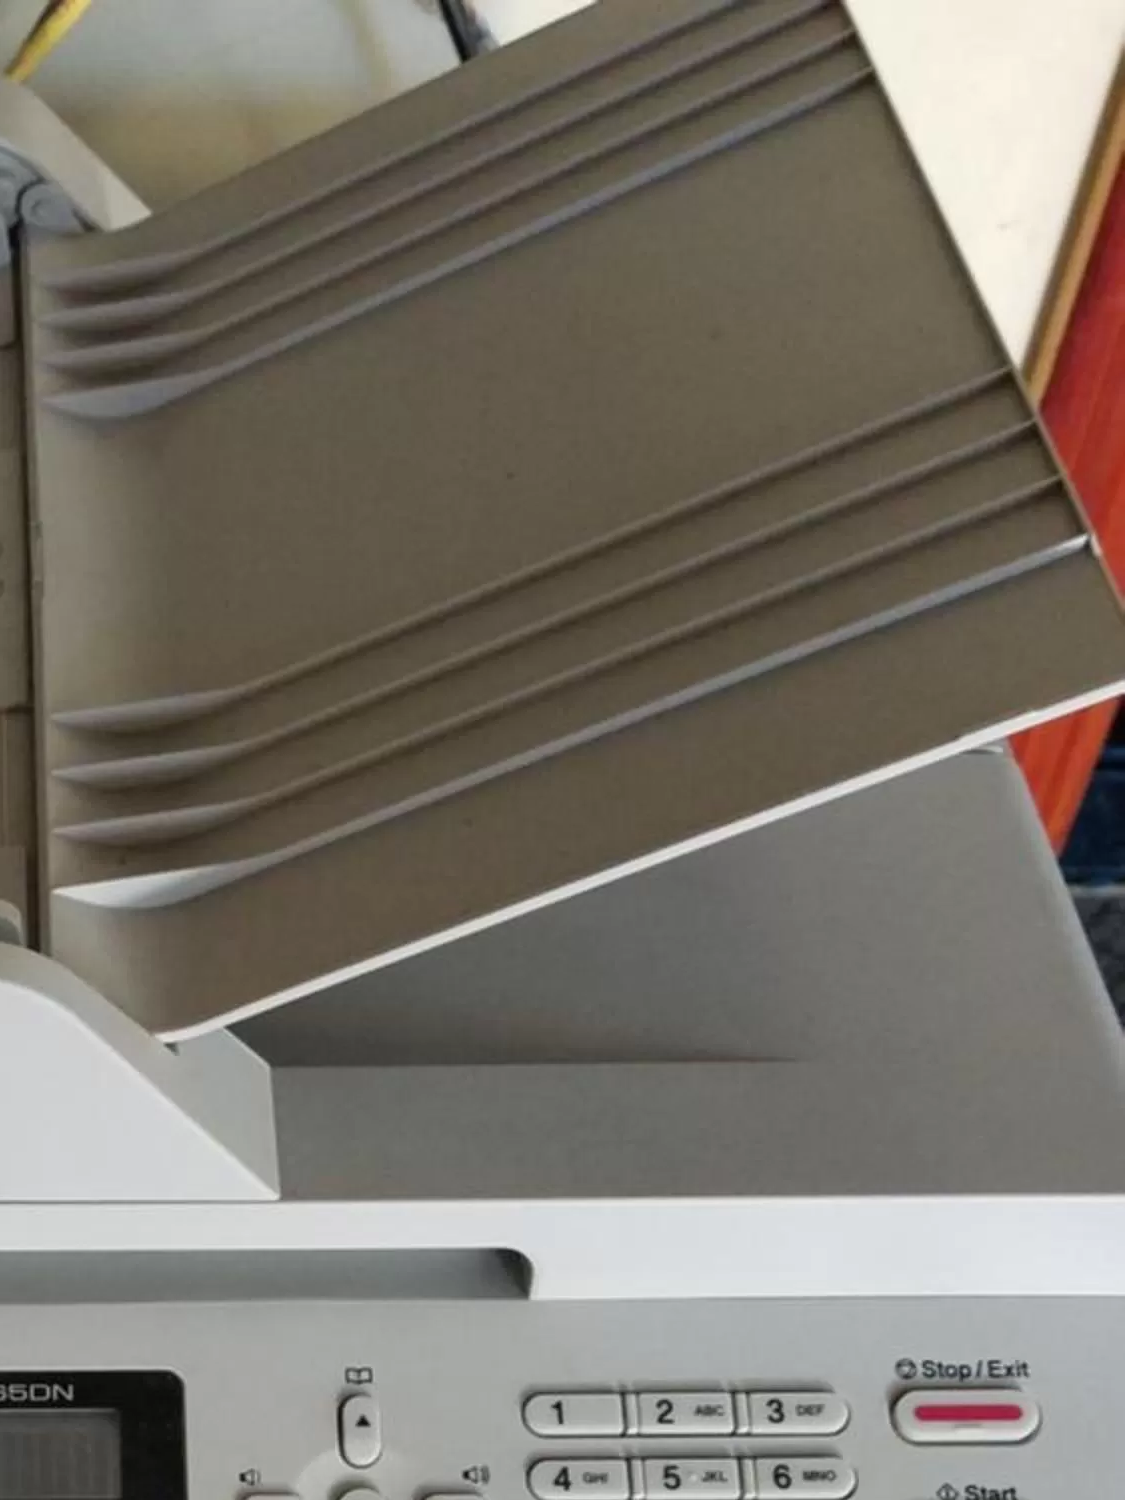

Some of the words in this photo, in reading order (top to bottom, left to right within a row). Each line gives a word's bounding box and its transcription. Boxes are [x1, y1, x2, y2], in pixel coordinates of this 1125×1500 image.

[551, 1400, 564, 1425] 1
[656, 1399, 674, 1424] 2
[766, 1398, 785, 1423] 3
[553, 1467, 572, 1491] 4
[663, 1465, 681, 1490] 5
[774, 1465, 792, 1489] 6
